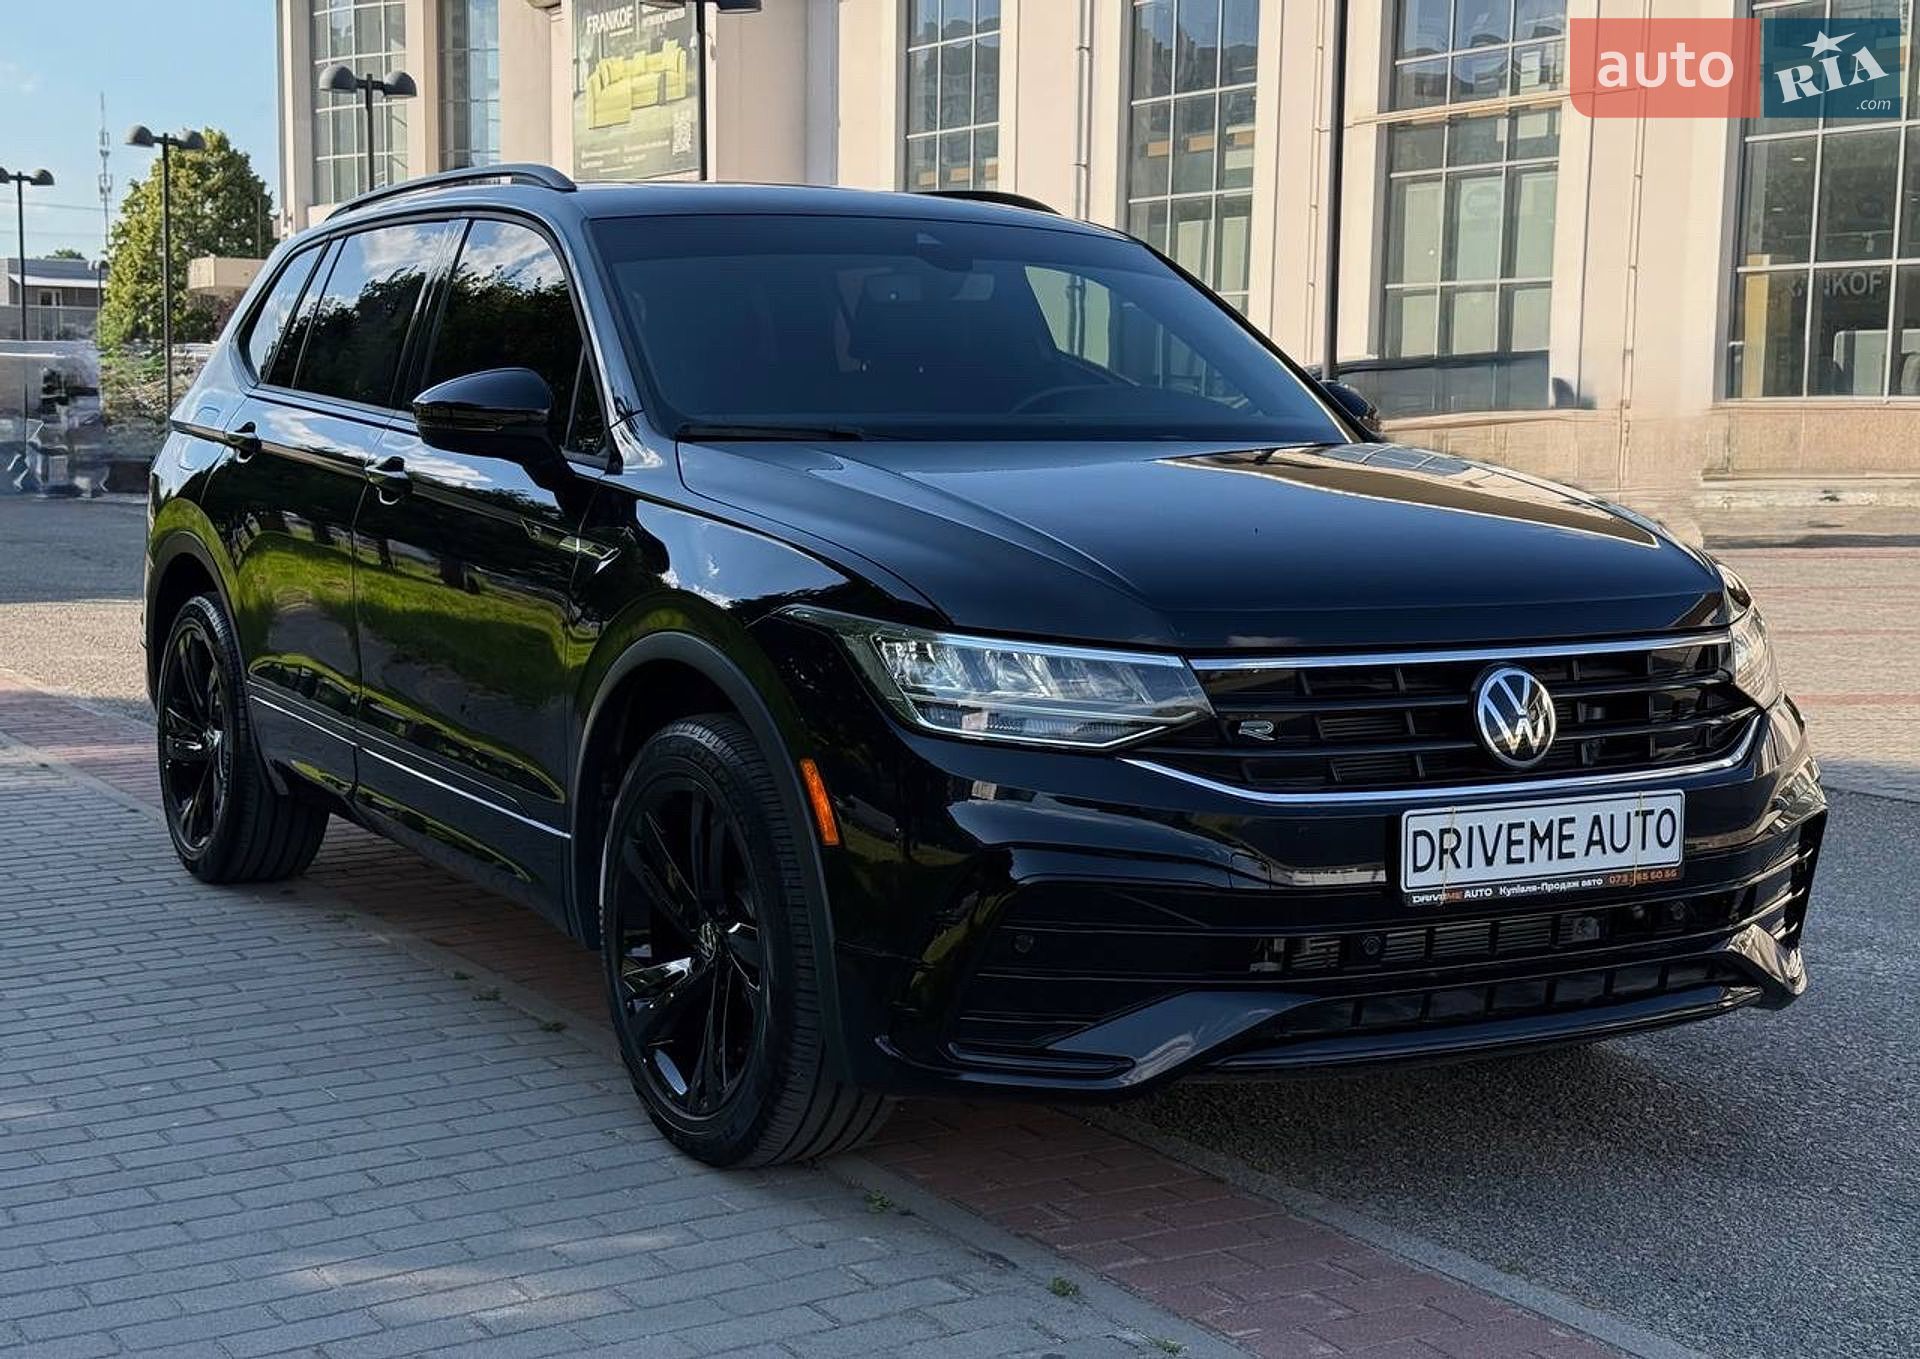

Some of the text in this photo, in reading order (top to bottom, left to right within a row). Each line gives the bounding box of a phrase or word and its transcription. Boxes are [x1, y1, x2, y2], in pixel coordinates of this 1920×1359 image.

[586, 5, 634, 34] FRANKOF
[1412, 808, 1677, 873] DRIVEME AUTO
[1464, 887, 1492, 899] AUTO
[1581, 877, 1603, 887] авто
